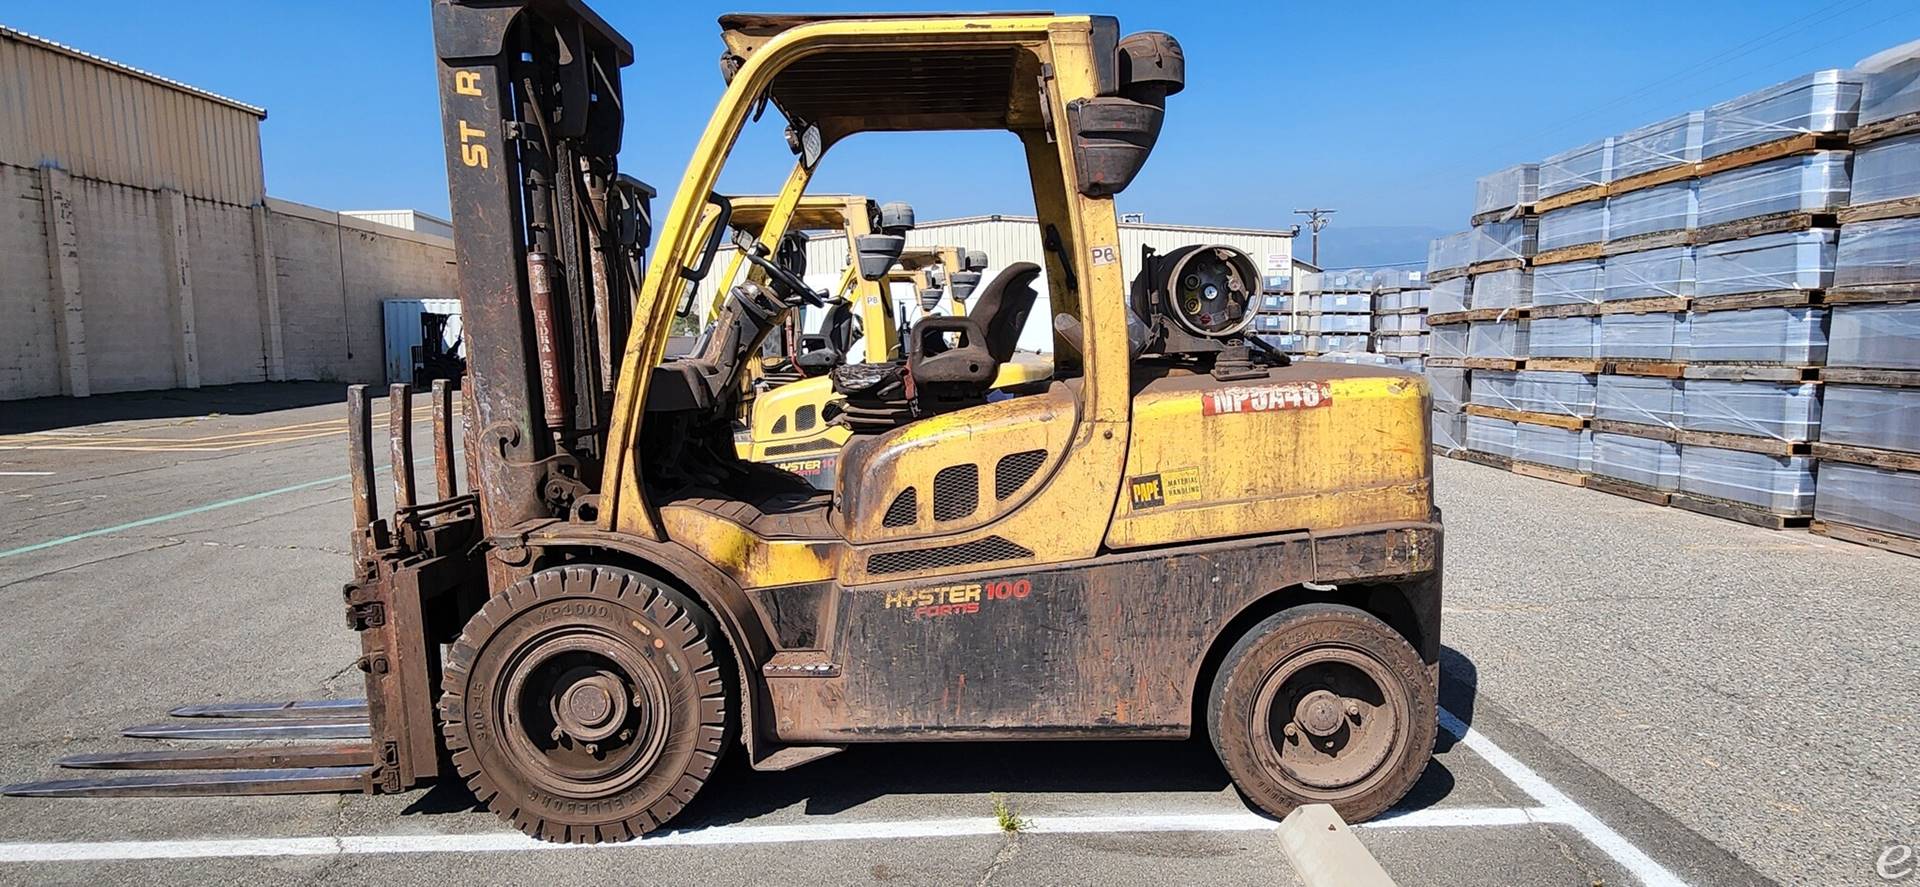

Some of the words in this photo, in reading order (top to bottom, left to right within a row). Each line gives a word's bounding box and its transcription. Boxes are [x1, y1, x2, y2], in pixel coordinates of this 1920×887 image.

[822, 458, 836, 468] 10
[1167, 477, 1198, 487] MATERIAL
[1168, 485, 1200, 496] HANDLING
[885, 584, 981, 609] HYSTER
[985, 579, 1032, 601] 100
[915, 602, 981, 619] FORTIS
